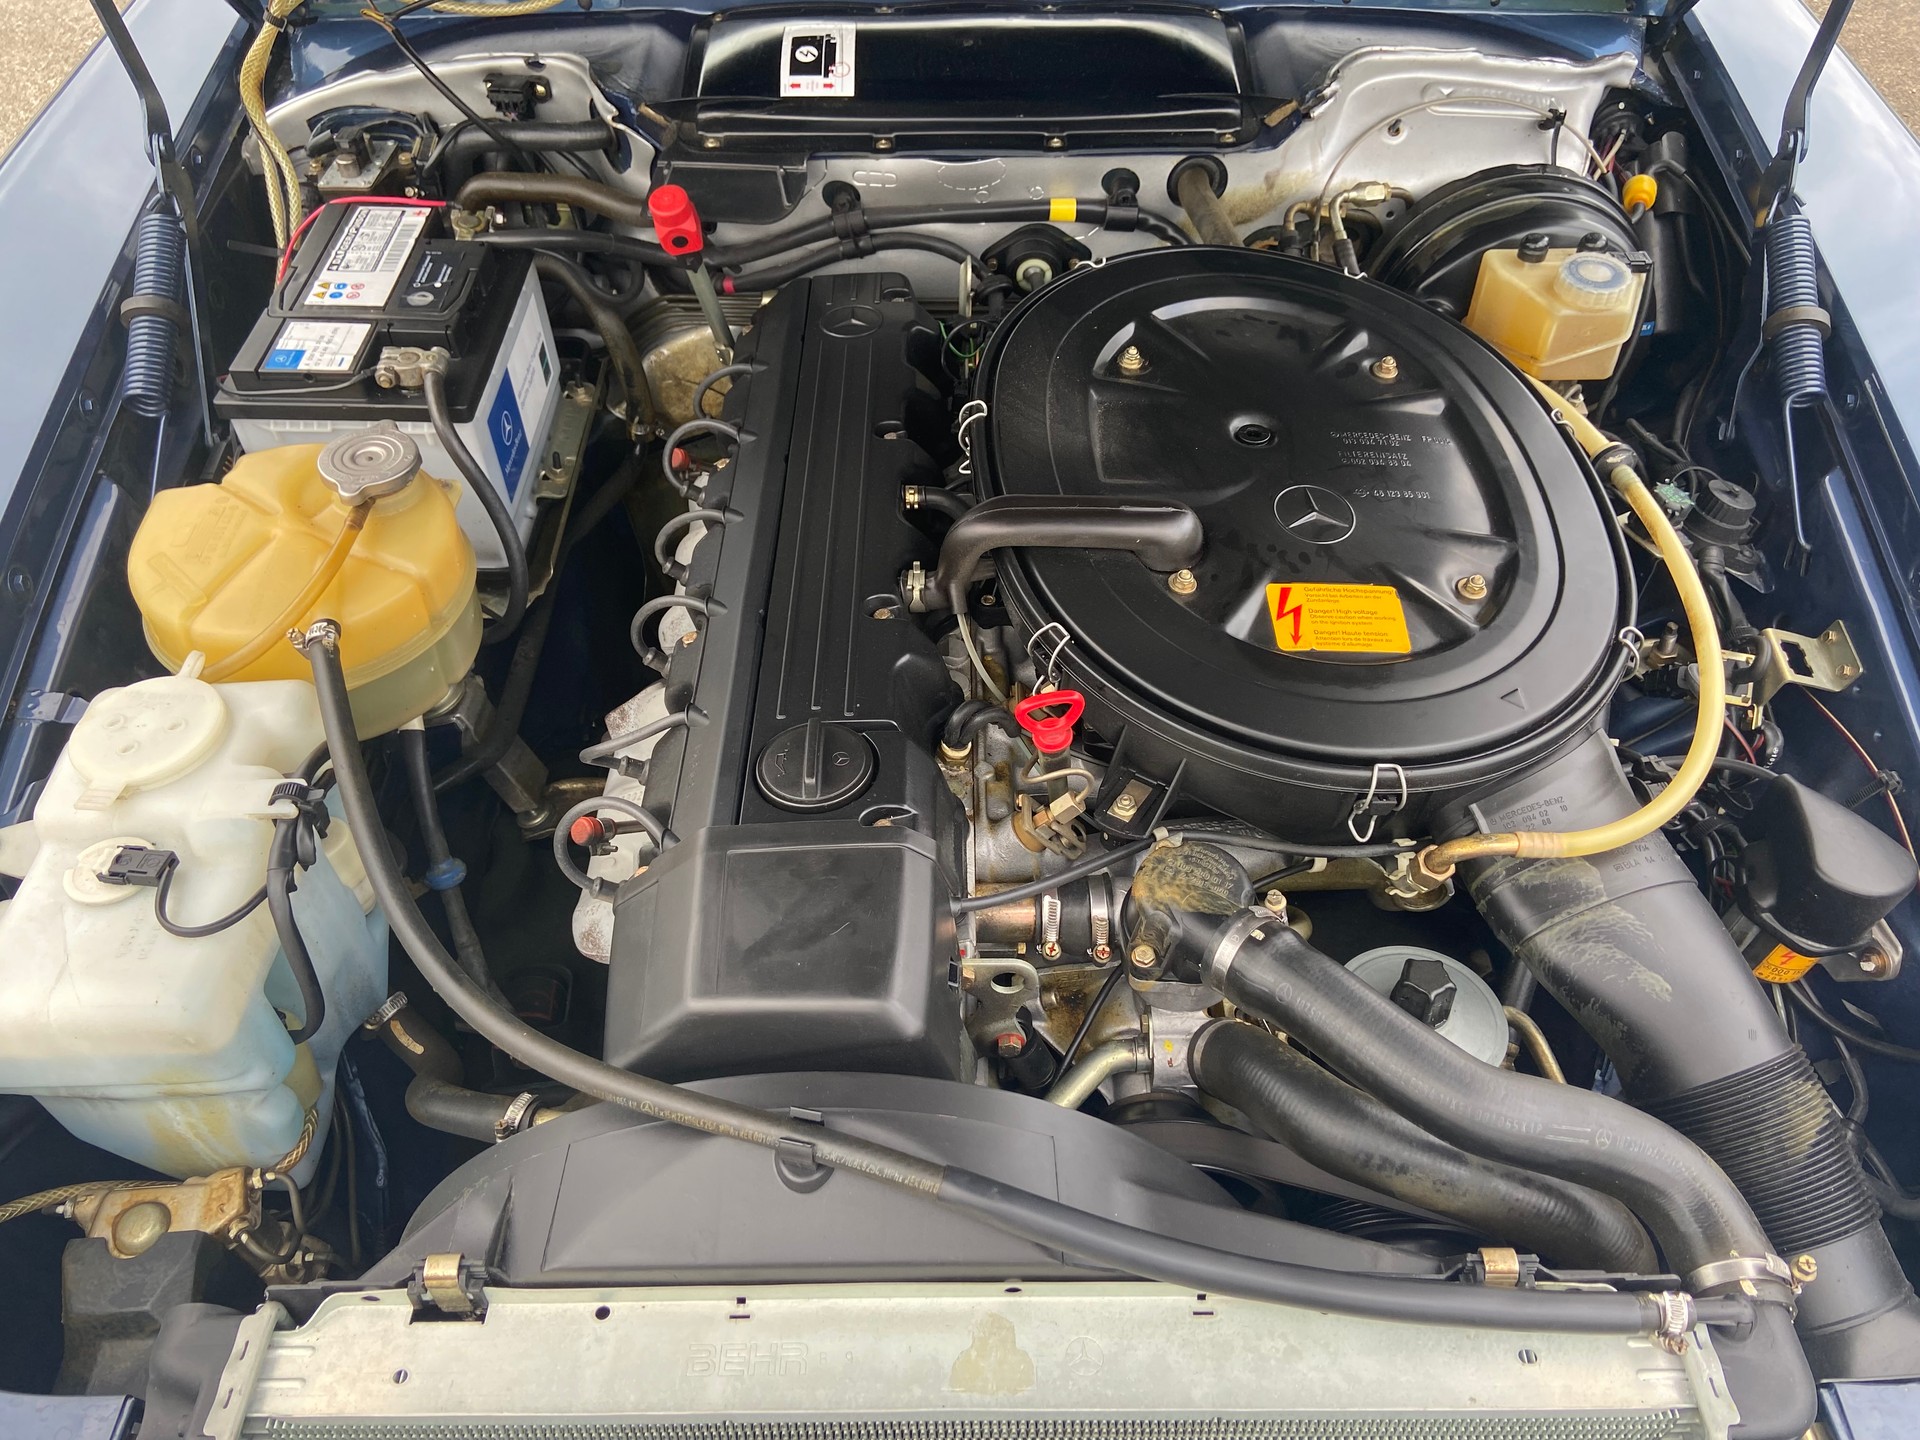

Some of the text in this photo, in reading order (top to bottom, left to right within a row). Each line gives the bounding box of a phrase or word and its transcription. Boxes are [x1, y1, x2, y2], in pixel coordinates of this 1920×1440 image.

[1498, 796, 1565, 821] MERCEDES-BENZ
[1539, 809, 1550, 818] 02
[686, 1342, 809, 1377] BEHR
